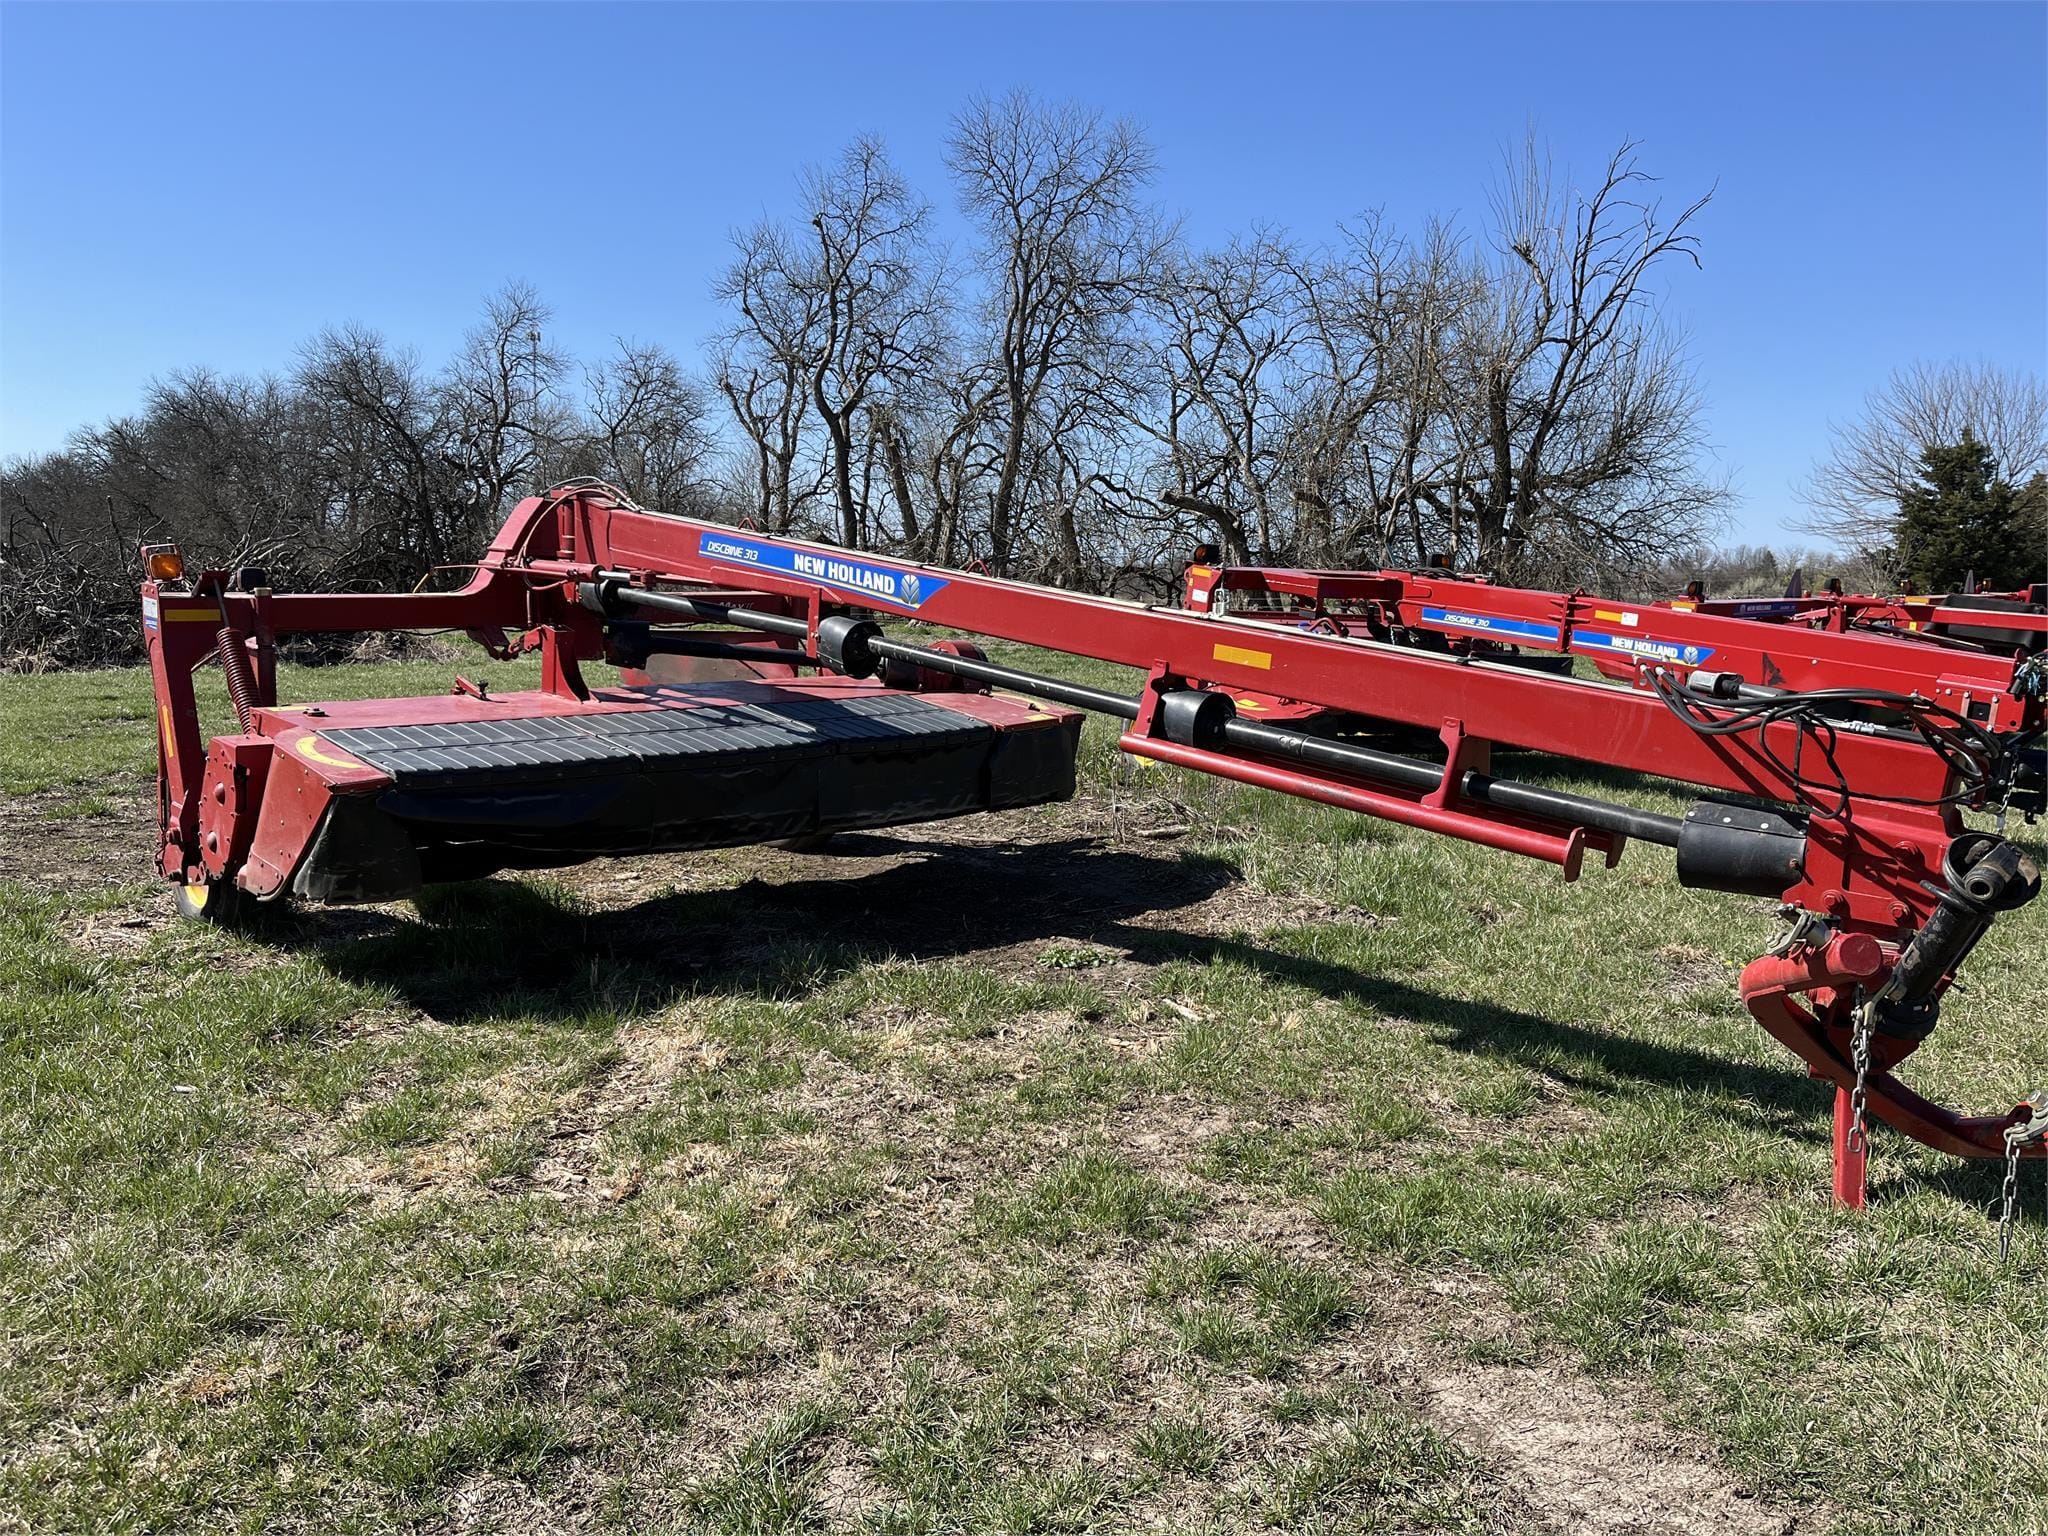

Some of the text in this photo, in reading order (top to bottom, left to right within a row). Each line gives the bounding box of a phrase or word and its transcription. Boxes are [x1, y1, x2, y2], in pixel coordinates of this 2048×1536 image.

[708, 541, 758, 560] DISCBINE 313
[794, 553, 895, 594] NEW HOLLAND
[1611, 636, 1678, 658] NEW HOLLAND
